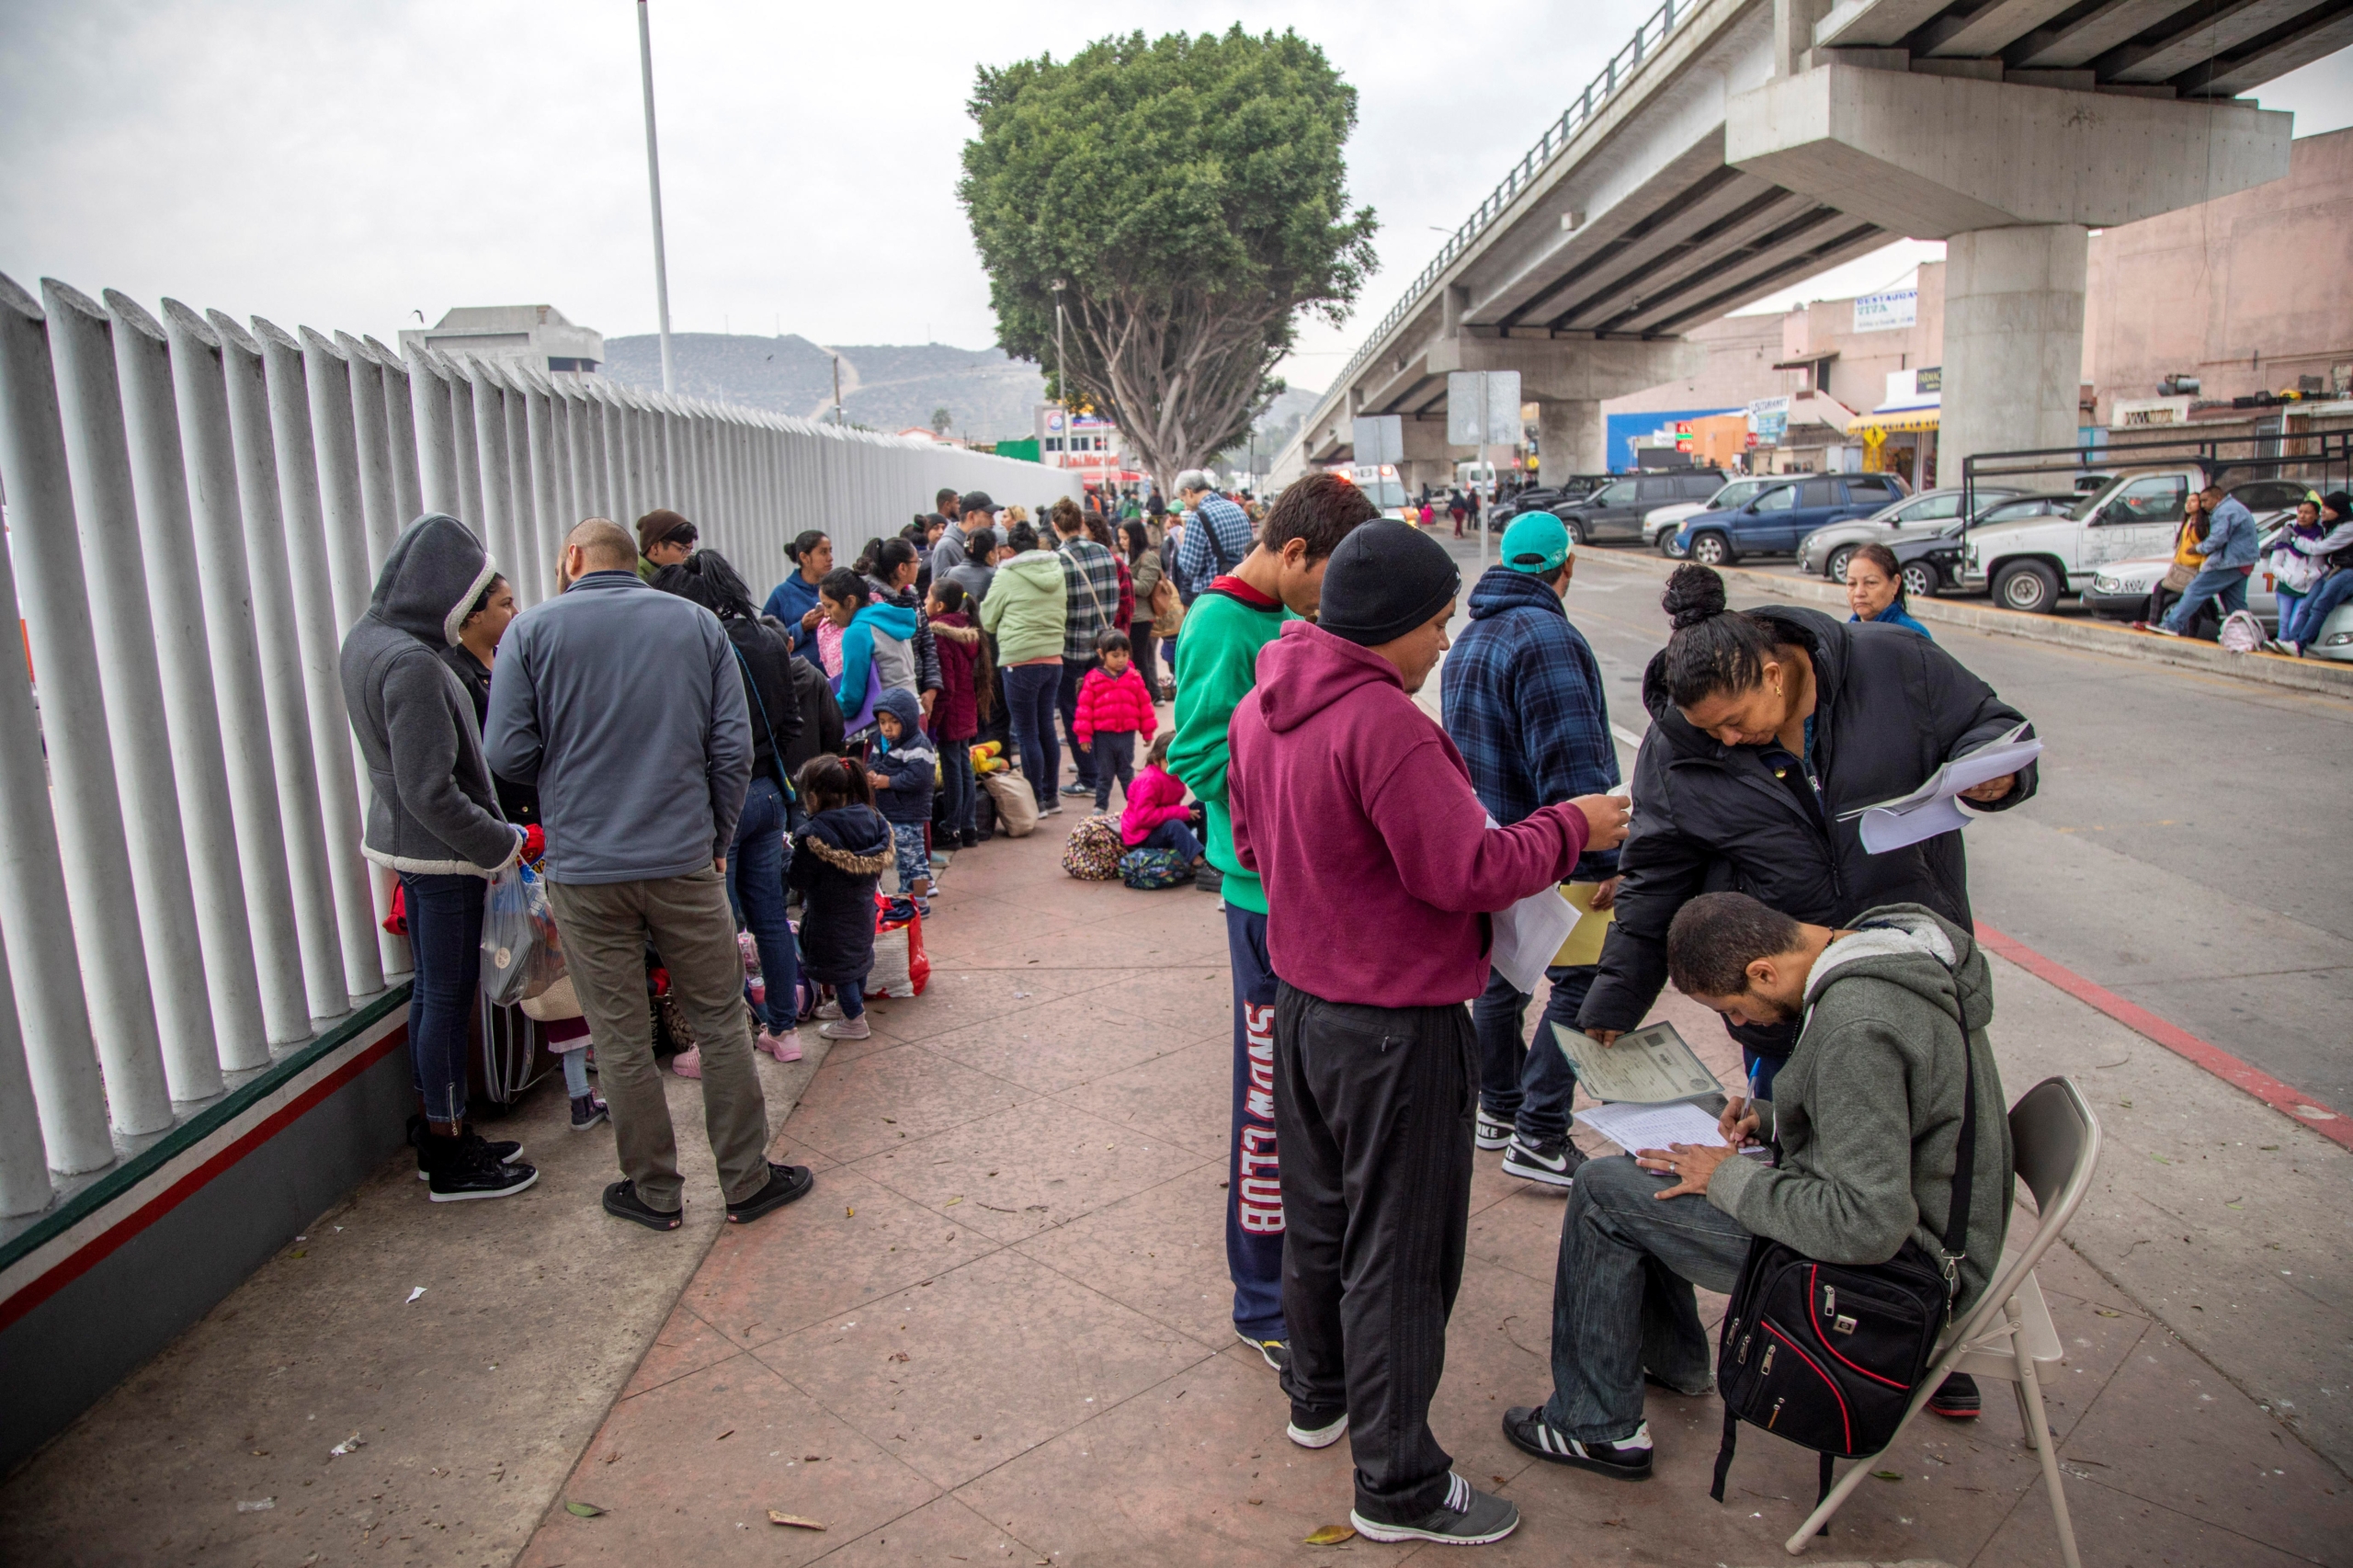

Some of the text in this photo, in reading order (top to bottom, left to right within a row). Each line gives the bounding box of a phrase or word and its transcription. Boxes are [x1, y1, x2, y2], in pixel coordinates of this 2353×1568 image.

[1858, 304, 1888, 315] VIVA
[1746, 435, 1760, 443] ALTO
[1477, 1122, 1498, 1139] IKE
[1239, 1123, 1287, 1236] CLUB
